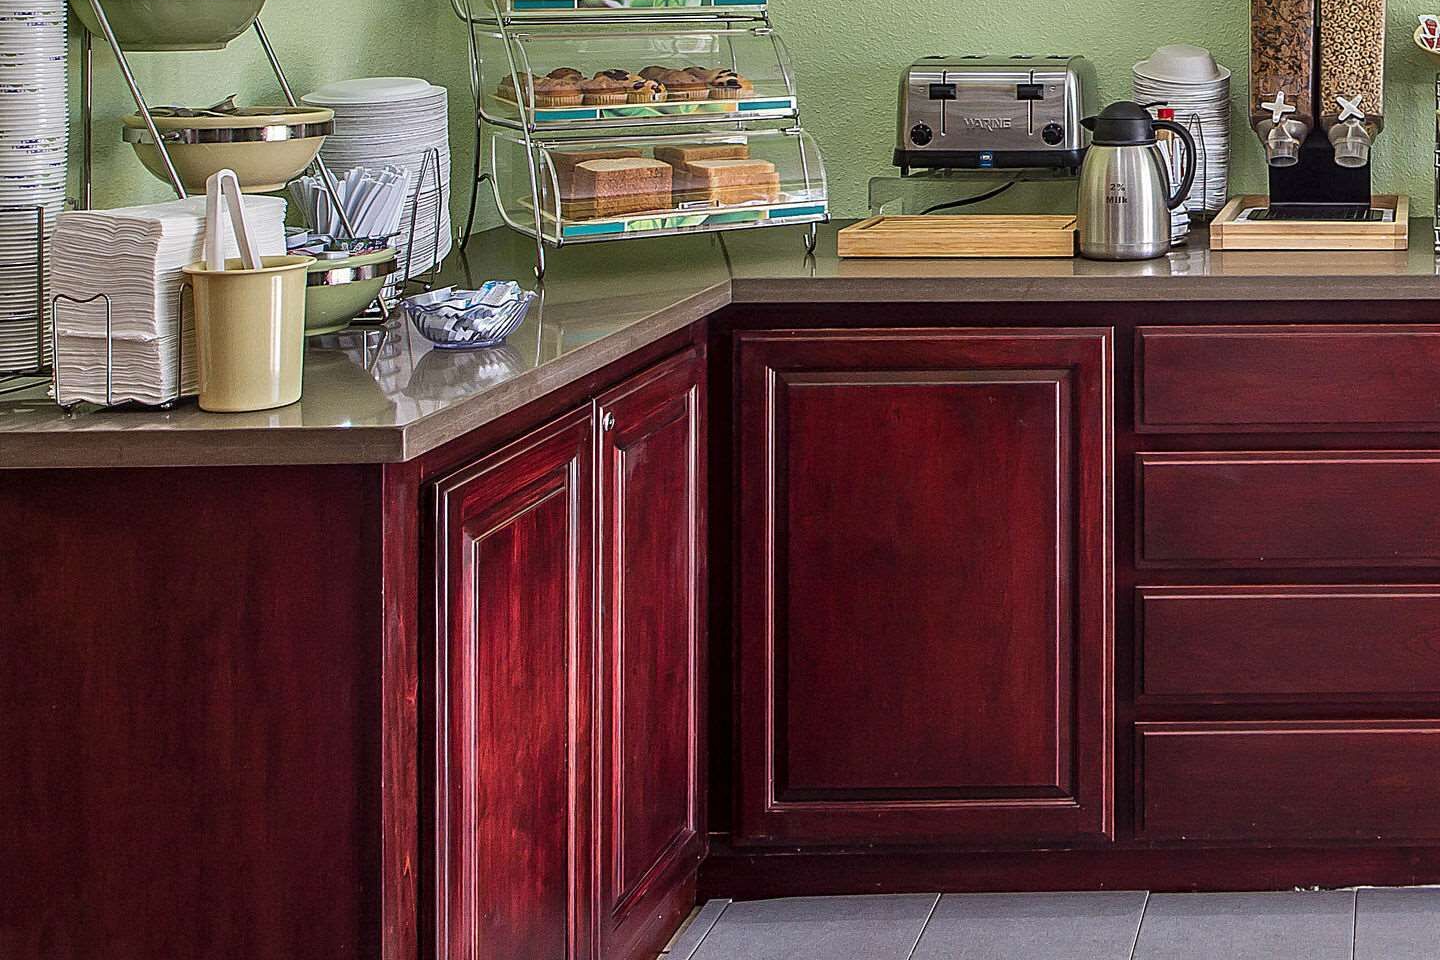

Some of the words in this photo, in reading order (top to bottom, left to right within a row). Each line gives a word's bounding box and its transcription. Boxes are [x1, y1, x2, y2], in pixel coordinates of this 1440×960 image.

[963, 117, 1012, 131] WARING
[1110, 183, 1126, 191] 2%
[1106, 195, 1128, 204] Milk
